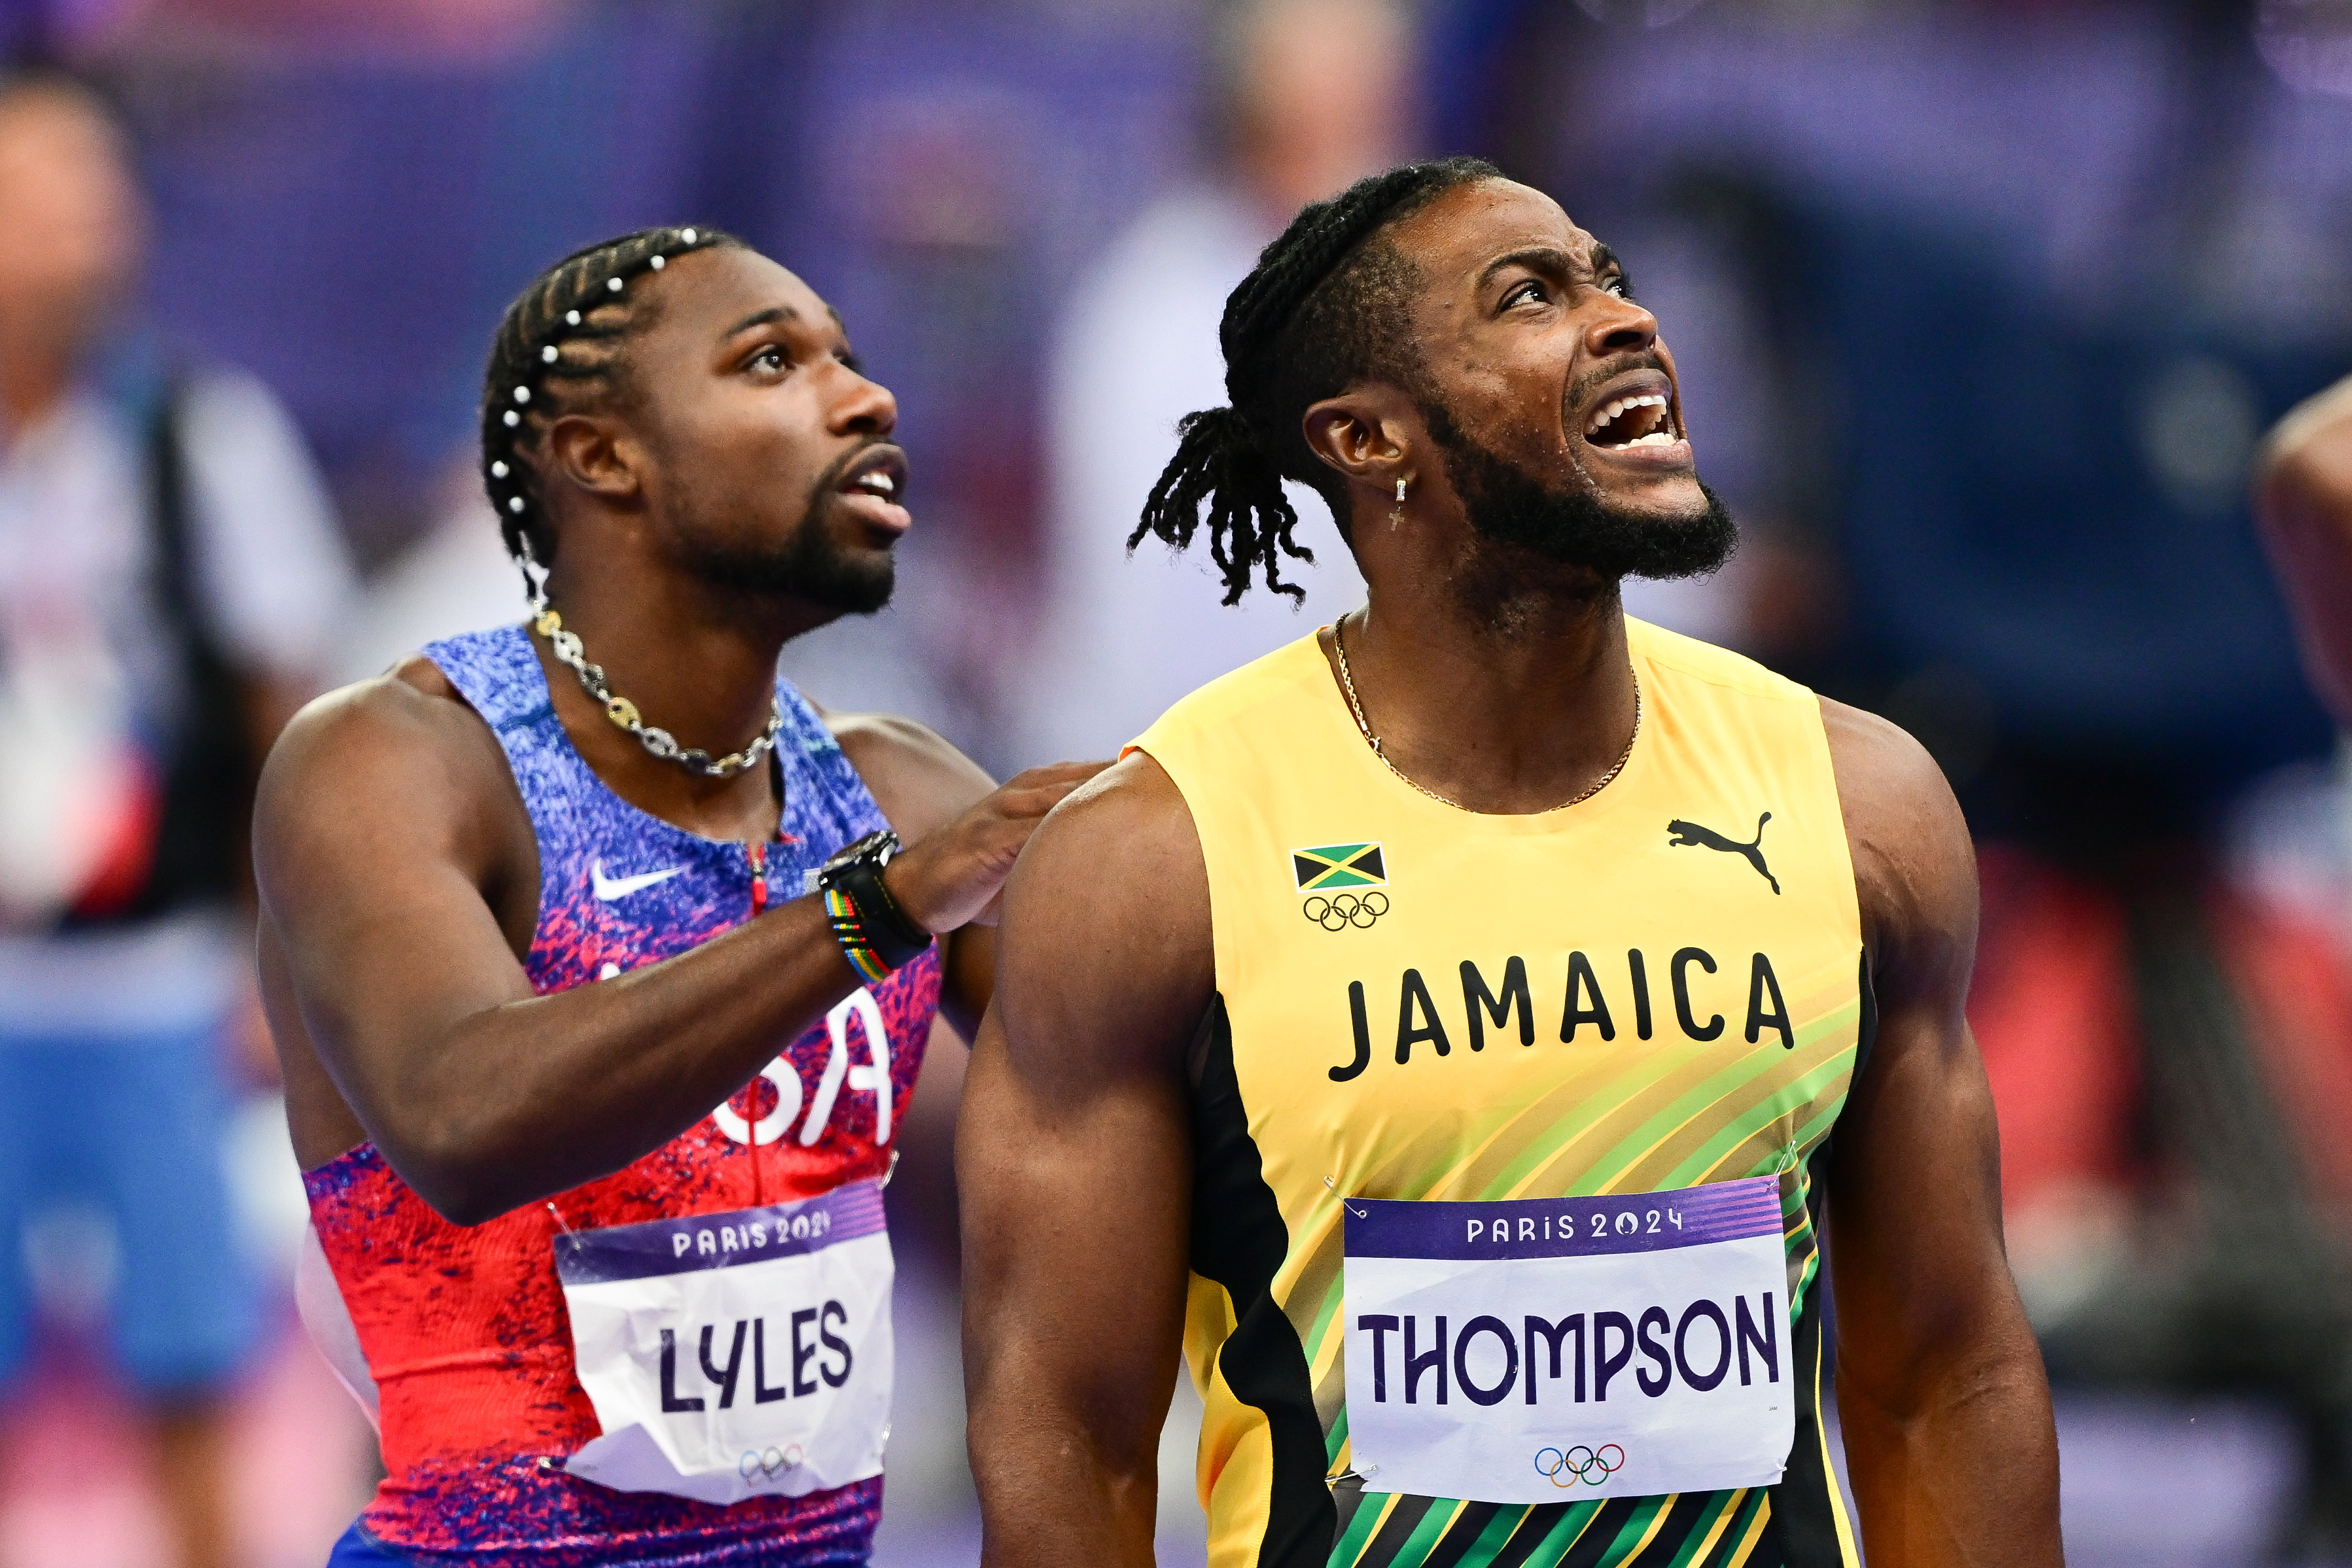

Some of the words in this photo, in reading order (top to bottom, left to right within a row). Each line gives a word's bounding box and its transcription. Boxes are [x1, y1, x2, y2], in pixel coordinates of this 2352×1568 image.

[1327, 947, 1795, 1083] JAMAICA
[1591, 1208, 1682, 1238] 2024
[659, 1300, 852, 1413] LYLES
[1358, 1291, 1780, 1406] THOMPSON
